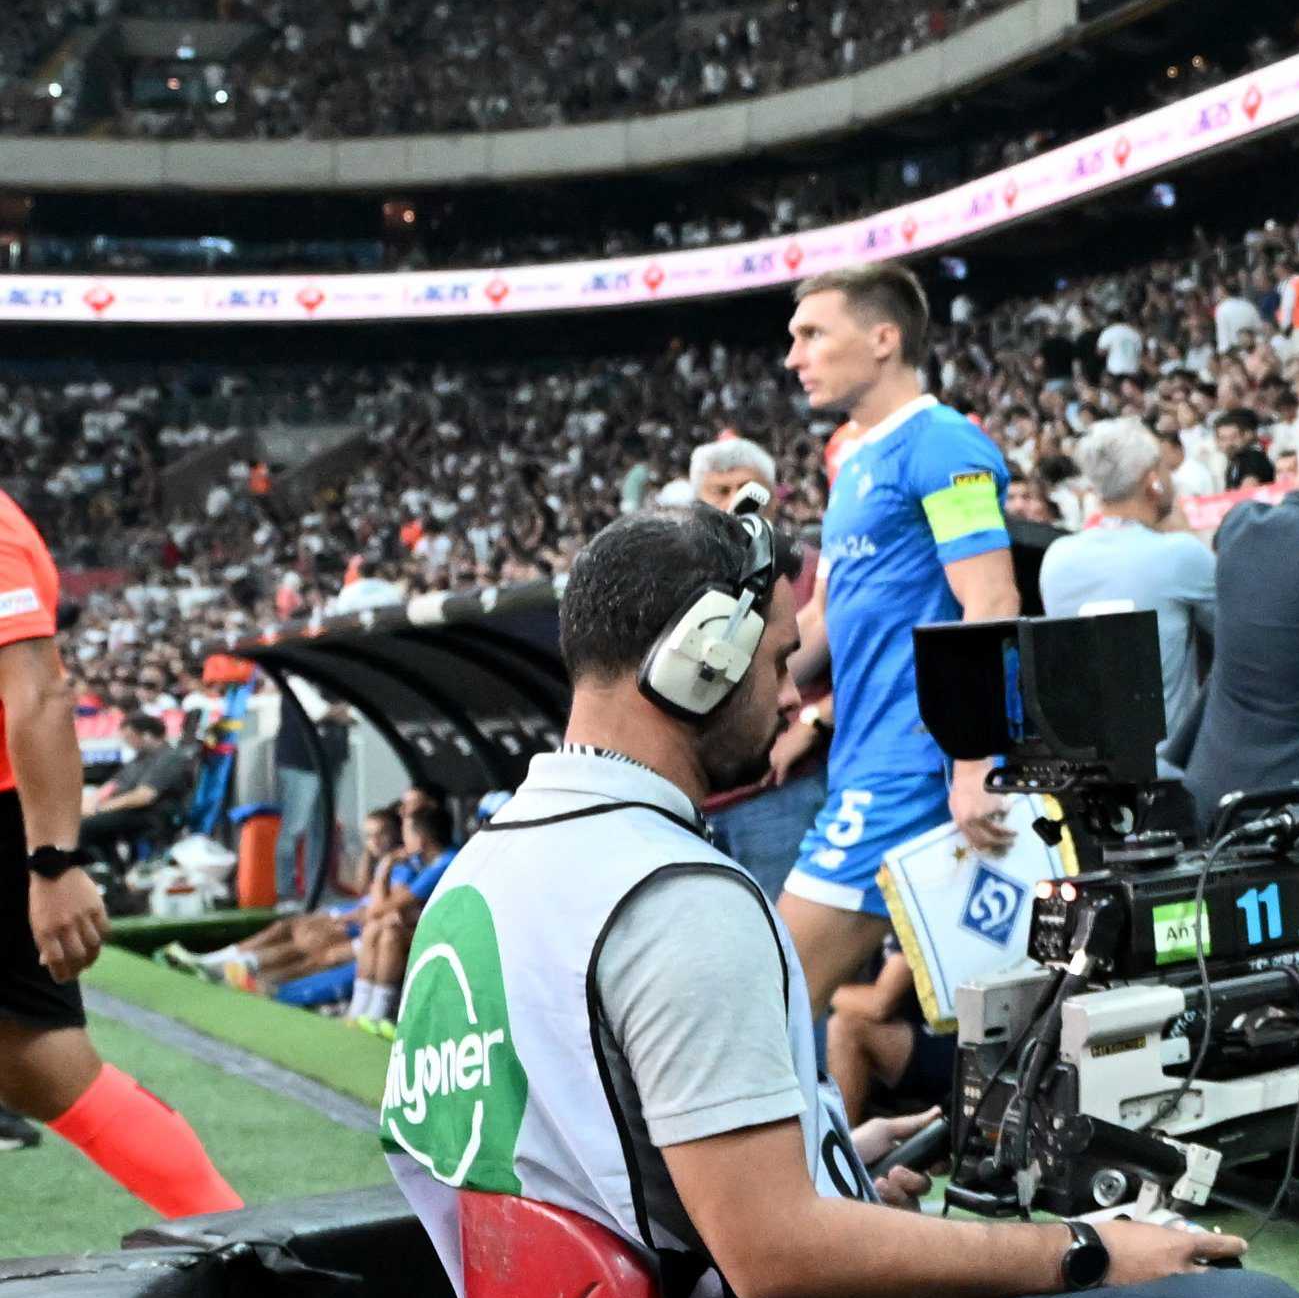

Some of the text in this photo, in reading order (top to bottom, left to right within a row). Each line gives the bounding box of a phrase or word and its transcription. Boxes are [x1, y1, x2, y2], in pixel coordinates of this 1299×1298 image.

[825, 788, 873, 848] 5
[1236, 882, 1283, 945] 11
[380, 1028, 505, 1125] ilyoner
